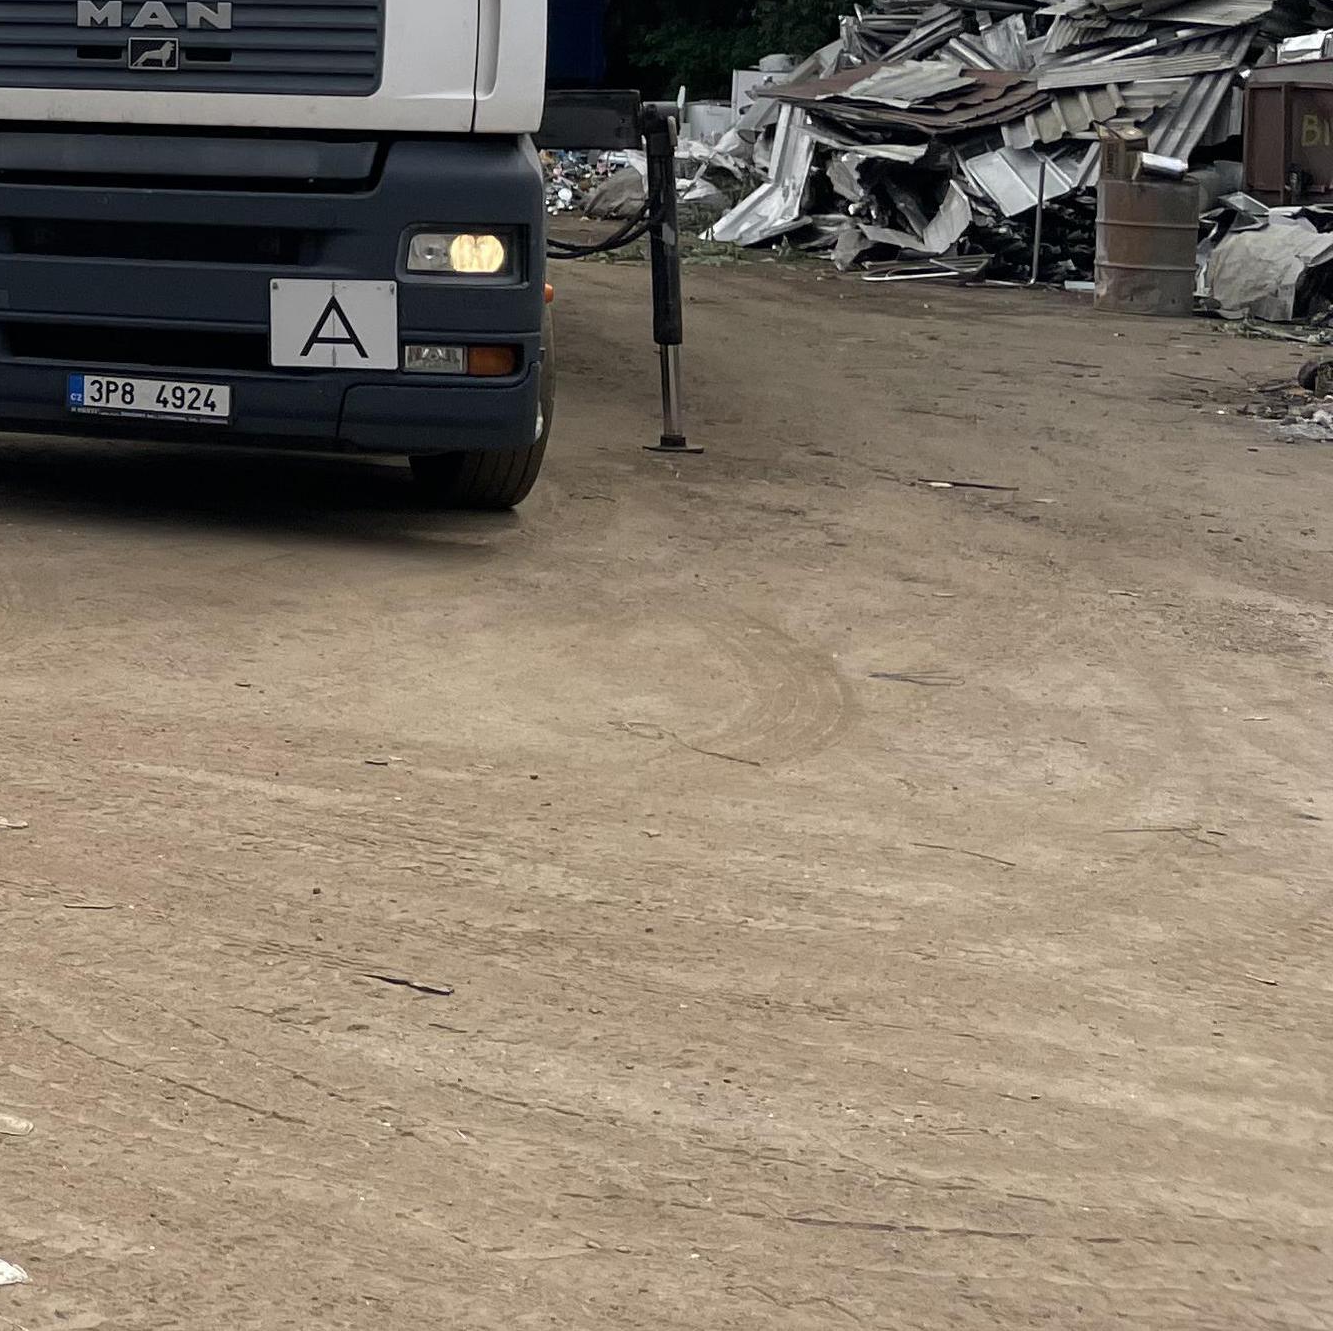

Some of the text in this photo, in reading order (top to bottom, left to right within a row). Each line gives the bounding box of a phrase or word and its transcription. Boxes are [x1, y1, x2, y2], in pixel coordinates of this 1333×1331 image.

[77, 0, 233, 30] MAN
[299, 295, 369, 359] A
[70, 392, 83, 402] CZ
[89, 379, 217, 412] 3P8 4924
